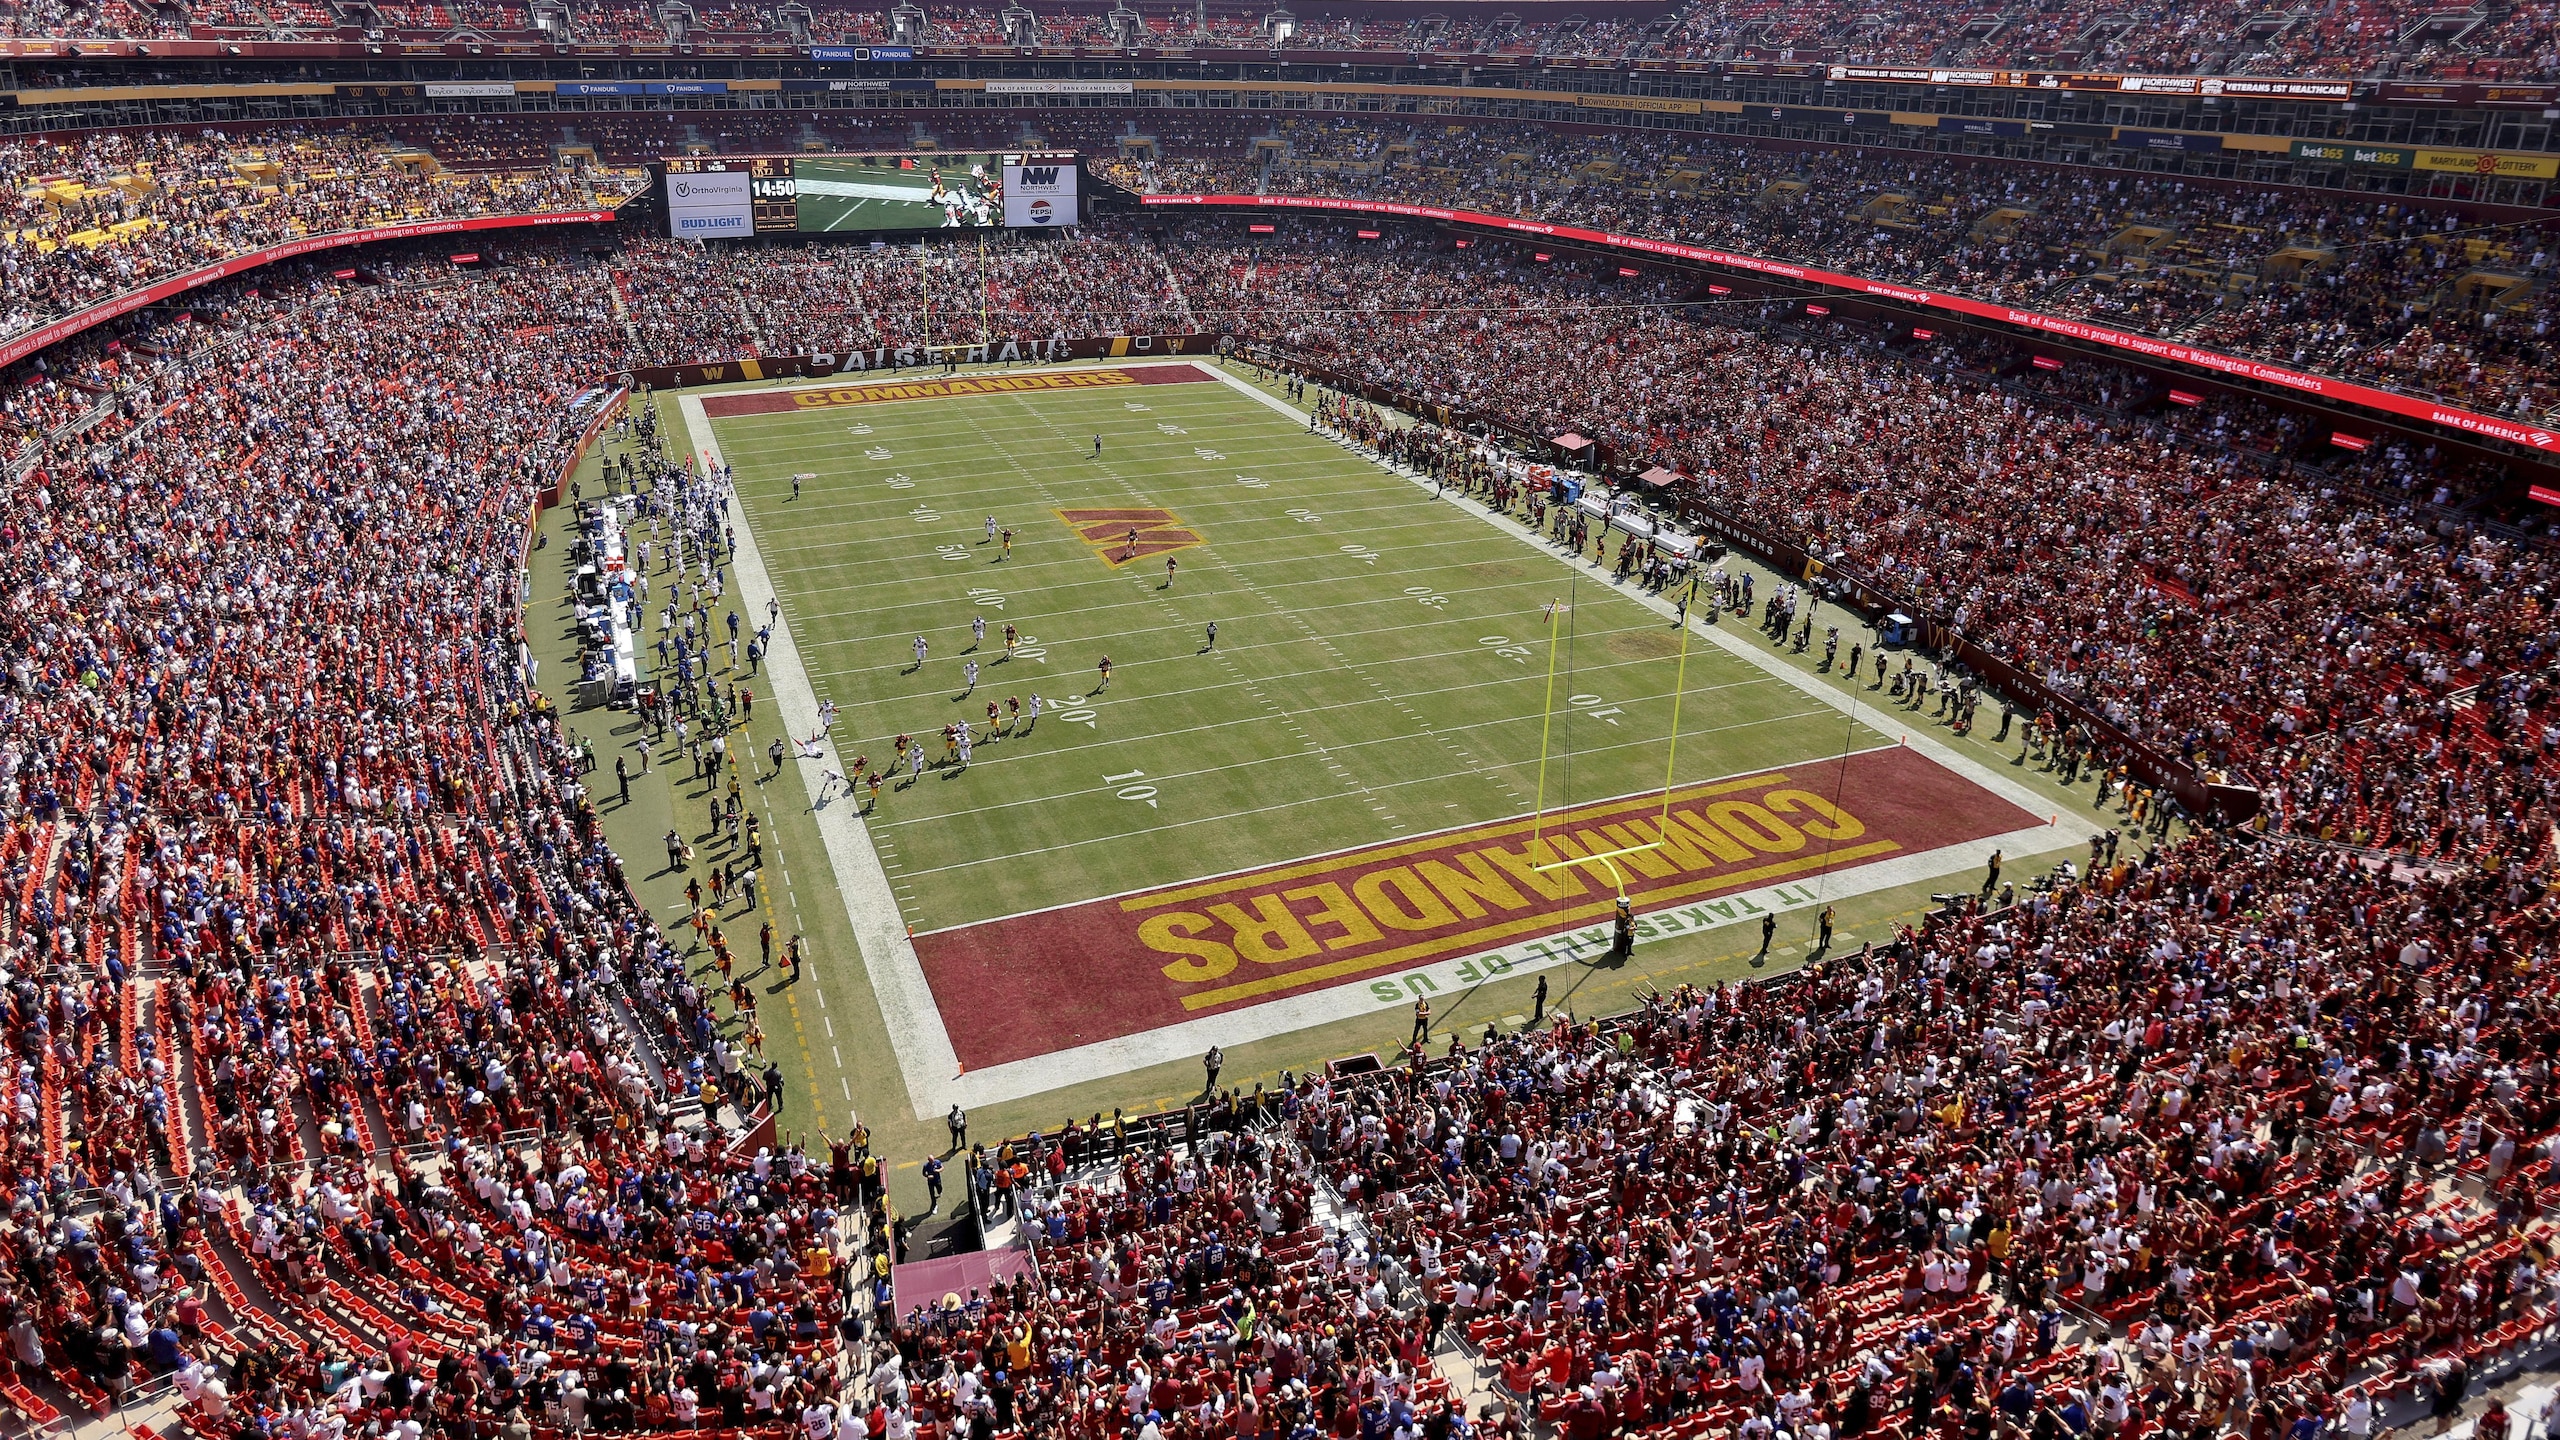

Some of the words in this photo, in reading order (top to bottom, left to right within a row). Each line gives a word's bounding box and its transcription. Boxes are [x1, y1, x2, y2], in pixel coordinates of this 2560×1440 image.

[1847, 70, 1877, 78] VETERANS
[1890, 71, 1928, 79] HEALTHCARE
[1949, 71, 1994, 80] NORTHWEST
[2142, 78, 2197, 87] NORTHWEST
[2226, 83, 2270, 92] VETERANS
[2272, 84, 2288, 93] 1ST
[2289, 85, 2348, 95] HEALTHCARE
[428, 88, 454, 96] Paycor
[1584, 98, 1619, 107] DOWNLOAD
[1622, 100, 1633, 108] THE
[1638, 101, 1666, 109] OFFICIAL
[2300, 145, 2344, 160] bet365
[2353, 150, 2400, 164] bet365
[2430, 156, 2477, 168] MARYLAND
[2497, 160, 2538, 171] LOTTERY
[1021, 167, 1059, 185] NW
[691, 186, 743, 195] OrthoVirginia
[752, 180, 795, 197] 14:50
[1286, 198, 1312, 206] America
[1322, 200, 1340, 208] proud
[1350, 202, 1374, 210] support
[1387, 203, 1420, 214] Washington
[1422, 207, 1454, 218] Commanders
[681, 218, 707, 228] BUD
[708, 217, 742, 227] LIGHT
[266, 250, 277, 260] Bank
[283, 245, 302, 256] America
[309, 240, 325, 252] proud
[334, 234, 359, 247] support
[373, 226, 414, 238] Washington
[416, 222, 464, 234] Commanders
[1606, 236, 1620, 244] Bank
[1629, 239, 1653, 250] America
[1661, 244, 1678, 254] proud
[1688, 249, 1711, 260] support
[1725, 254, 1762, 269] Washington
[1763, 262, 1804, 277] Commanders
[1867, 285, 1882, 294] BANK
[1890, 289, 1917, 300] AMERICA
[10, 342, 31, 356] America
[37, 330, 53, 347] proud
[61, 319, 81, 337] support
[82, 316, 90, 327] our
[90, 306, 118, 322] Washington
[117, 294, 150, 311] Commanders
[2008, 311, 2028, 323] Bank
[2031, 314, 2041, 325] of
[2042, 318, 2078, 334] America
[2080, 326, 2088, 336] is
[2091, 330, 2117, 344] proud
[2119, 335, 2128, 345] to
[2132, 339, 2168, 356] support
[2170, 347, 2187, 359] our
[2189, 349, 2249, 373] Washington
[2252, 364, 2322, 391] Commanders
[793, 371, 1135, 407] COMMANDERS
[1124, 402, 1151, 412] 10
[847, 425, 873, 435] 10
[1157, 423, 1188, 435] 20
[2431, 412, 2460, 425] BANK
[2462, 419, 2476, 429] OF
[2477, 423, 2527, 442] AMERICA
[864, 449, 893, 460] 20
[1195, 447, 1226, 461] 30
[885, 477, 916, 489] 30
[1237, 475, 1270, 489] 40
[908, 508, 941, 522] 40
[1284, 508, 1322, 523] 50
[1688, 508, 1774, 555] COMMANDERS
[935, 544, 971, 561] 50
[1340, 544, 1381, 564] 40
[966, 587, 1006, 606] 40
[1403, 586, 1449, 607] 30
[1003, 635, 1047, 659] 30
[1478, 635, 1532, 661] 20
[1046, 694, 1097, 724] 20
[1568, 694, 1626, 721] 10
[2011, 678, 2037, 698] 1937
[2043, 697, 2071, 718] 1942
[2147, 761, 2178, 786] 1991
[1101, 768, 1158, 801] 10
[1138, 787, 1866, 984] COMMANDERS
[1773, 884, 1818, 906] IT
[1635, 897, 1765, 938] TAKES
[1524, 928, 1611, 961] ALL
[1454, 954, 1514, 983] OF
[1369, 972, 1439, 1002] US
[1583, 1043, 1593, 1052] 21
[383, 1056, 391, 1066] 8
[1417, 1057, 1423, 1065] 9
[1365, 1124, 1374, 1133] 99
[349, 1175, 364, 1187] 91
[745, 1181, 754, 1190] 10
[695, 1220, 711, 1231] 56
[527, 1238, 535, 1249] 17
[1211, 1253, 1223, 1264] 89
[1239, 1271, 1251, 1282] 99
[1154, 1290, 1168, 1301] 97
[571, 1327, 585, 1340] 92
[648, 1330, 660, 1343] 21
[305, 1362, 315, 1376] 17
[587, 1370, 599, 1381] 21
[1869, 1395, 1886, 1408] 99
[811, 1420, 826, 1431] 26
